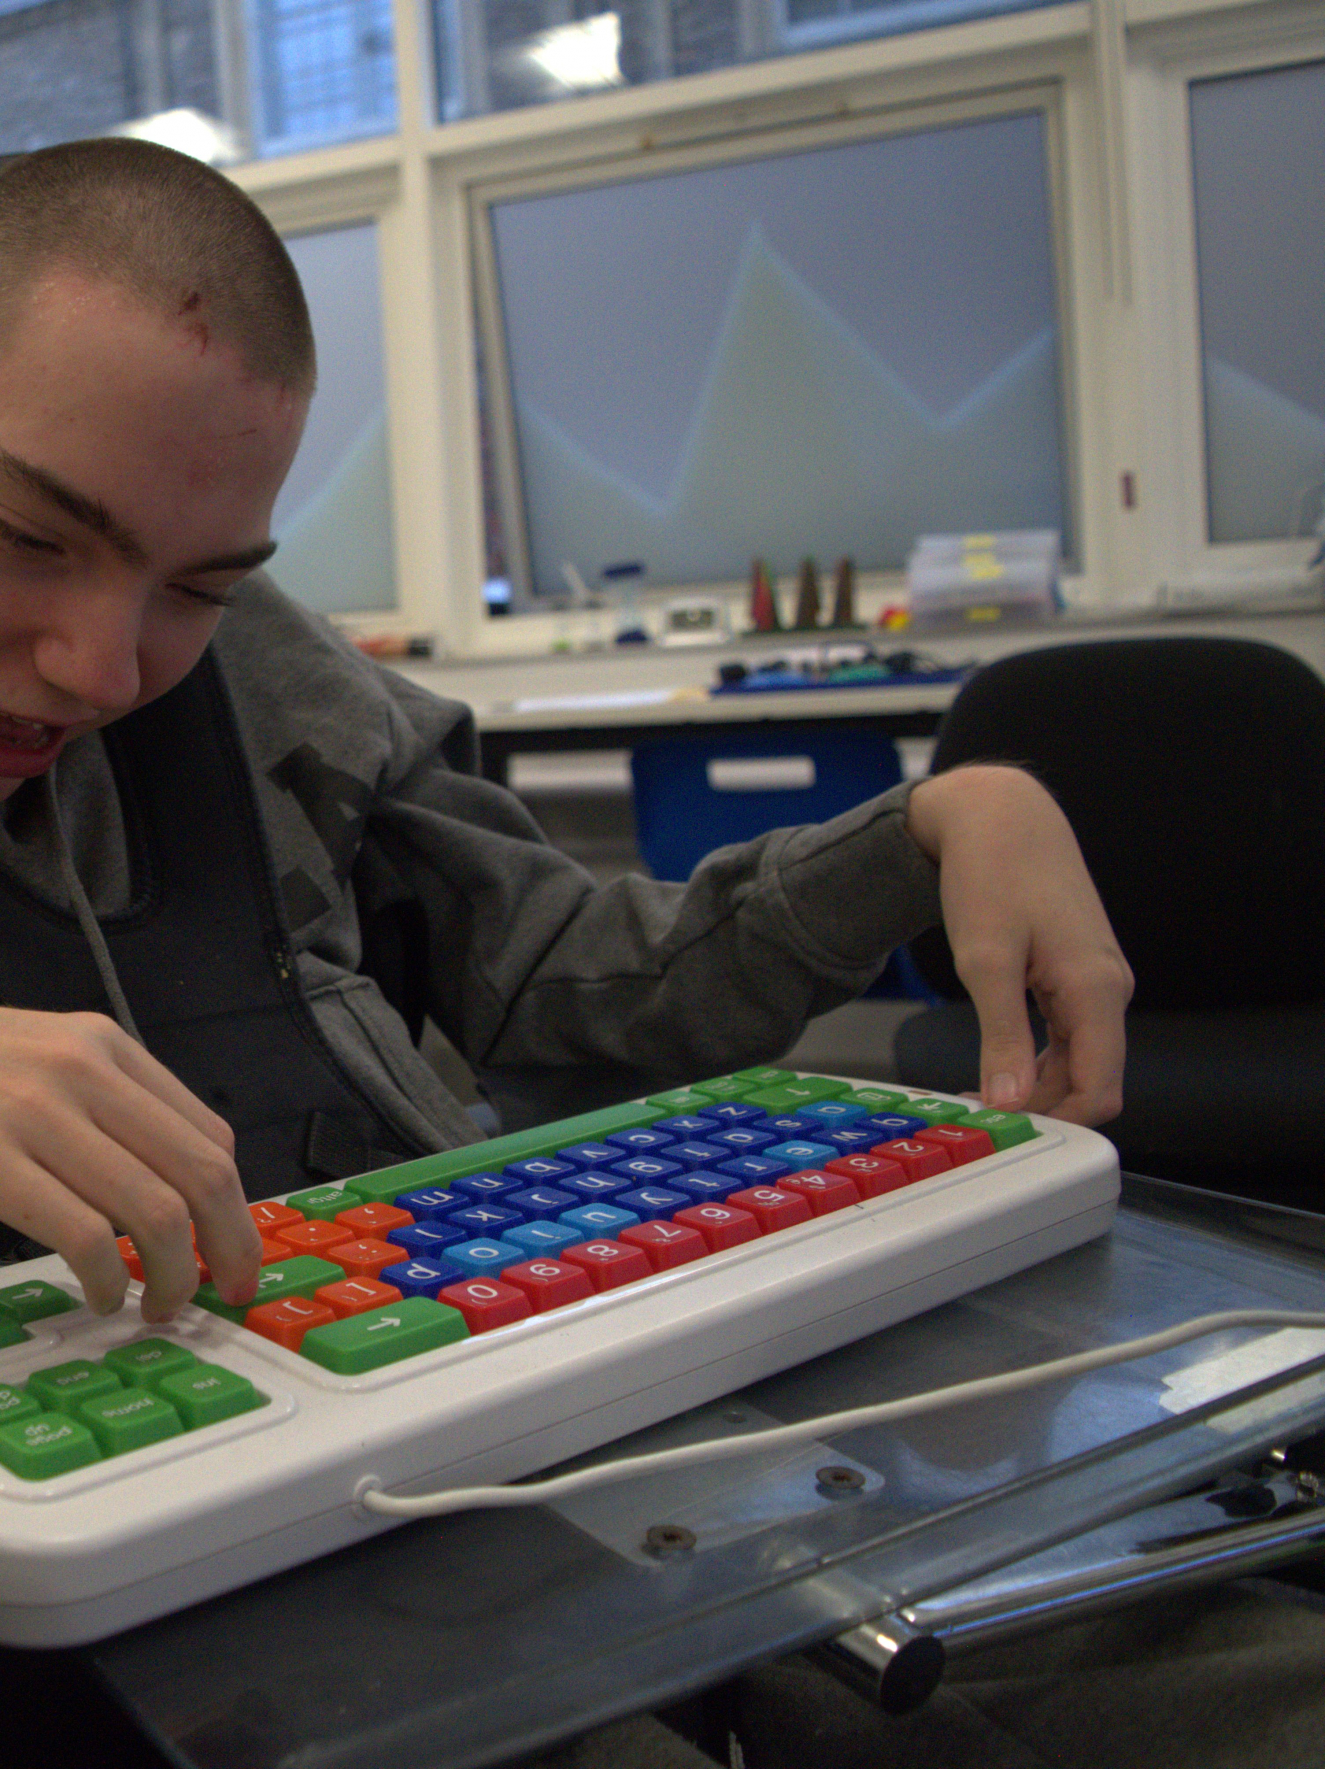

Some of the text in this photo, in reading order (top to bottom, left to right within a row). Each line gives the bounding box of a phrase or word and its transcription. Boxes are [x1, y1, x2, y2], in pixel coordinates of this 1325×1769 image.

[718, 1106, 747, 1117] z
[674, 1119, 704, 1130] x
[775, 1119, 802, 1129] s
[628, 1133, 658, 1144] c
[832, 1131, 868, 1143] w
[785, 1146, 815, 1156] e
[892, 1142, 924, 1153] 2
[581, 1149, 610, 1160] v
[524, 1161, 562, 1173] b
[628, 1161, 664, 1173] g
[849, 1157, 879, 1169] 3
[471, 1178, 504, 1190] n
[576, 1176, 617, 1188] h
[688, 1177, 720, 1188] t
[800, 1174, 826, 1187] 4
[411, 1191, 454, 1207] m
[531, 1192, 560, 1206] j
[640, 1191, 673, 1205] y
[753, 1189, 785, 1202] 5
[463, 1208, 504, 1223] k
[581, 1210, 617, 1223] u
[700, 1207, 731, 1220] 6
[530, 1228, 561, 1240] i
[654, 1224, 682, 1239] 7
[586, 1243, 620, 1258] 8
[407, 1262, 441, 1279] p
[529, 1264, 562, 1277] 9
[466, 1284, 500, 1300] 0
[102, 1396, 155, 1418] home
[25, 1423, 50, 1437] up
